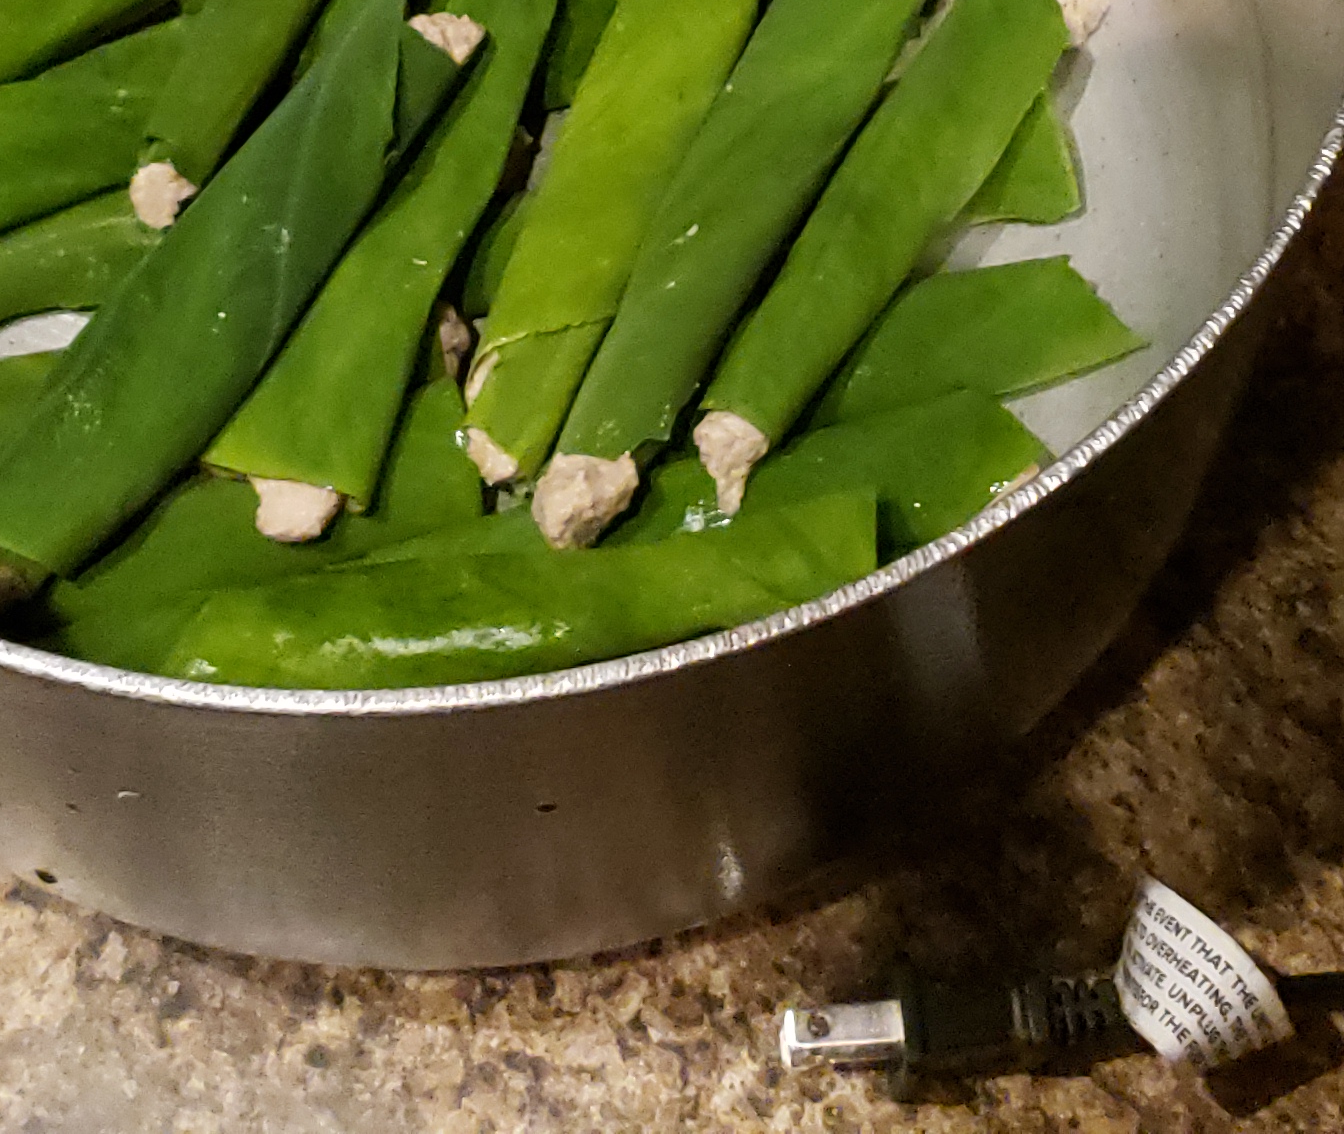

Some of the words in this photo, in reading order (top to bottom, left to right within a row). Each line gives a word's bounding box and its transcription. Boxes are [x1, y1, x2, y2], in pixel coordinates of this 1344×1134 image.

[1154, 907, 1193, 942] EVENT
[1191, 935, 1234, 975] THAT
[1231, 973, 1259, 1010] THE
[1159, 1008, 1192, 1044] THE
[1168, 983, 1221, 1043] UNPLUG
